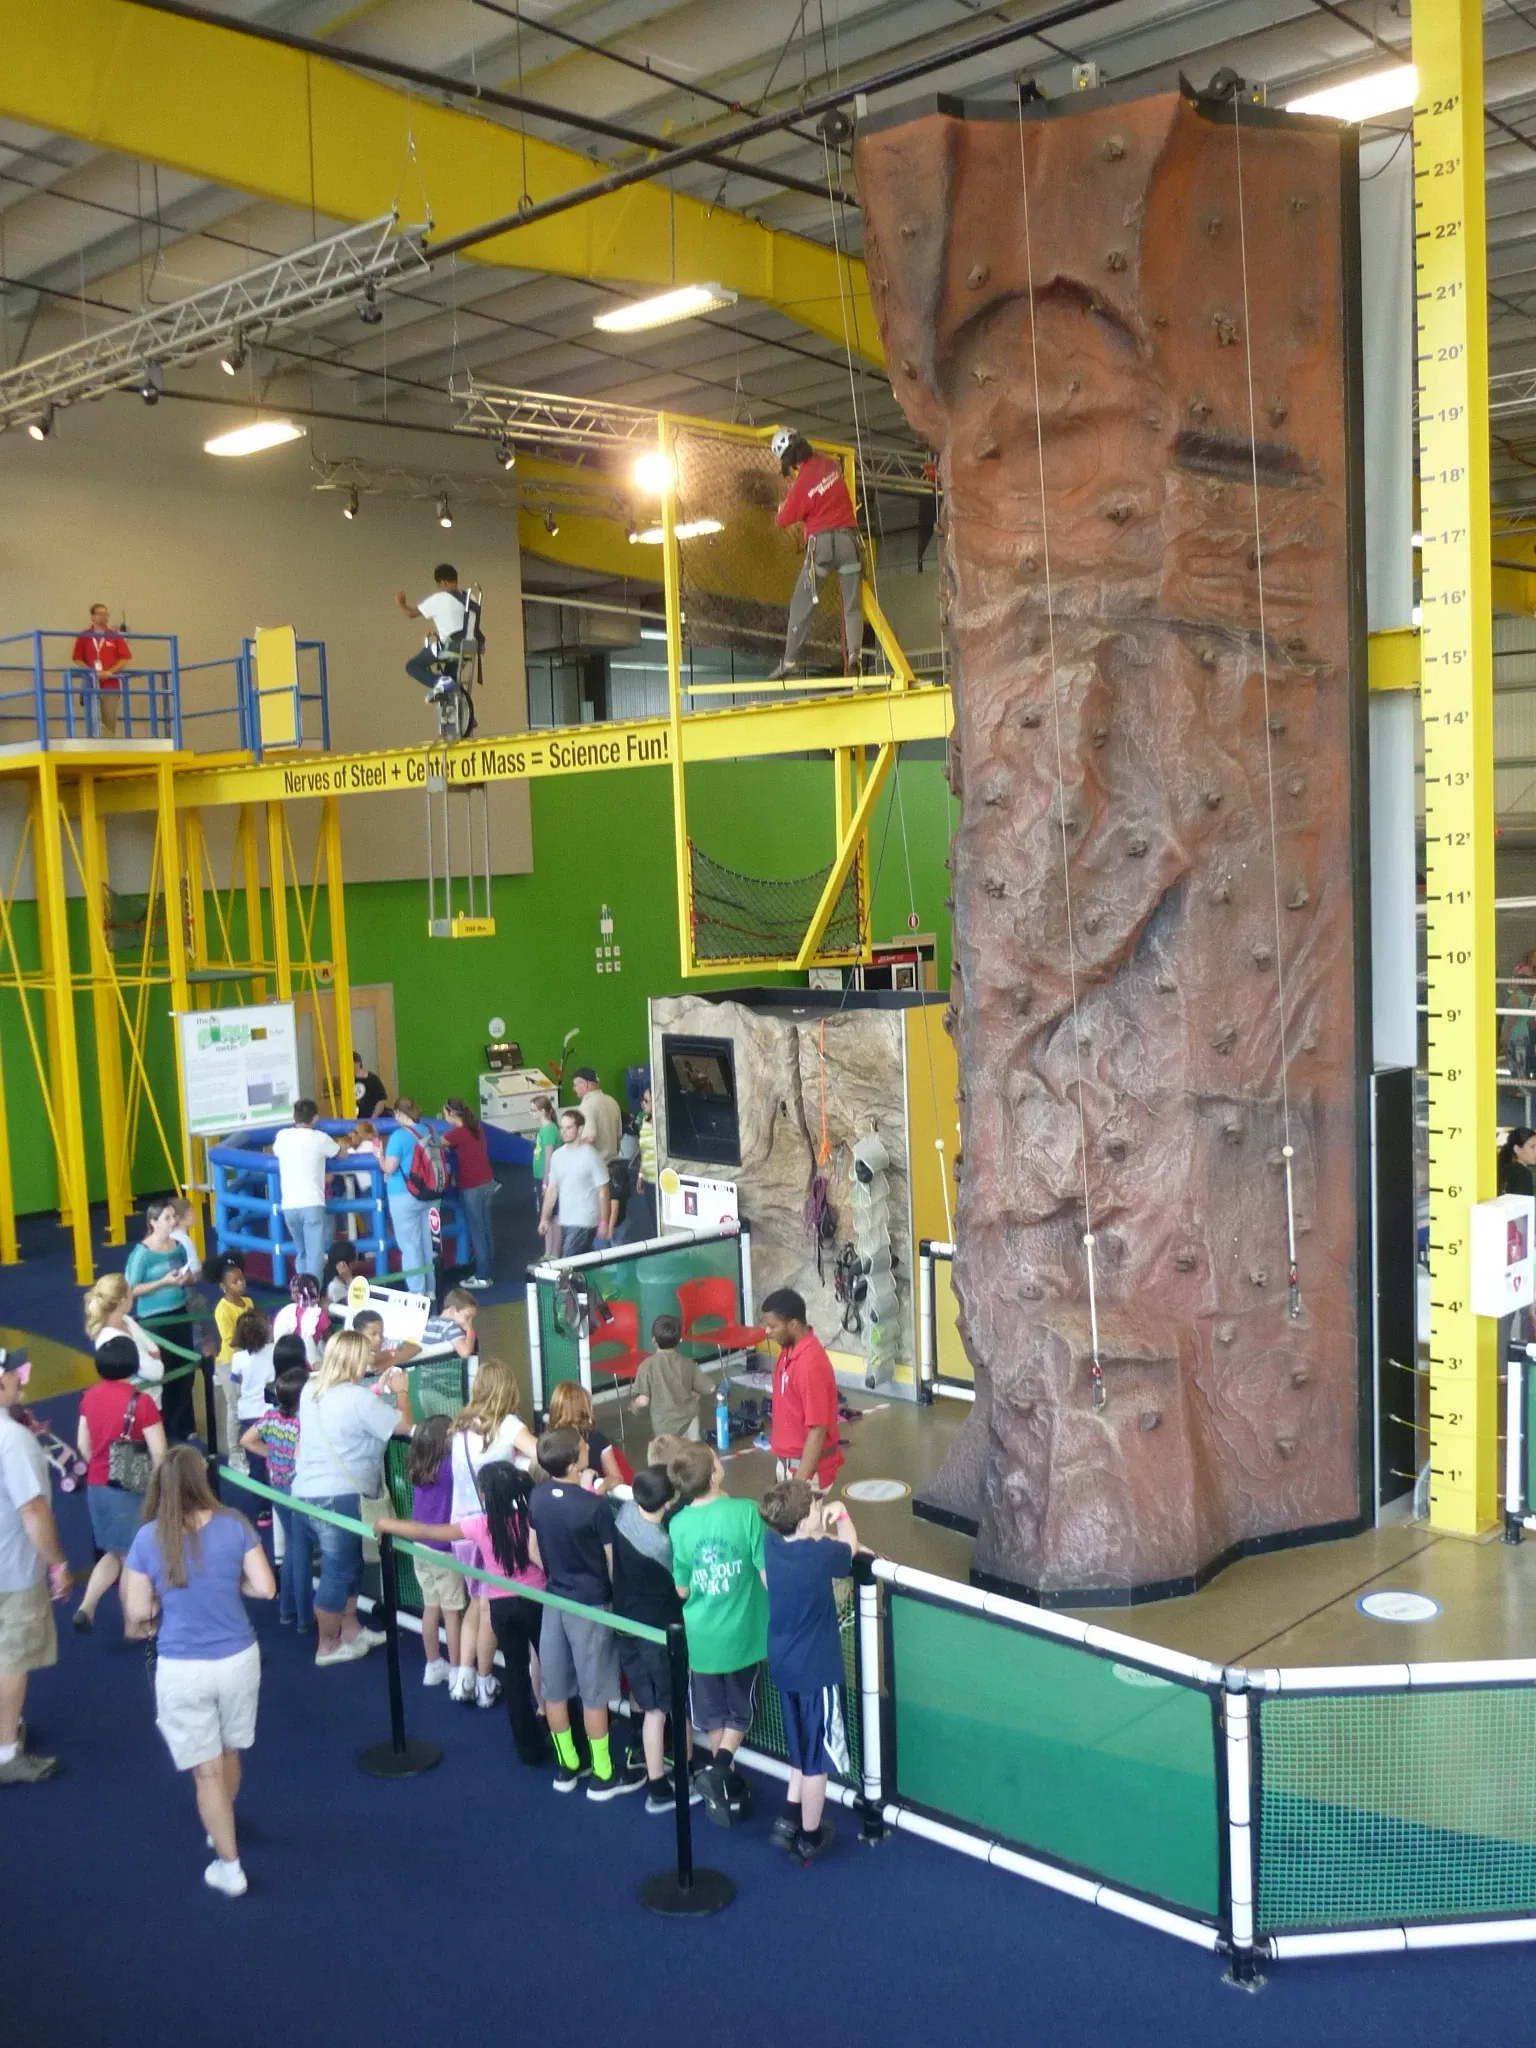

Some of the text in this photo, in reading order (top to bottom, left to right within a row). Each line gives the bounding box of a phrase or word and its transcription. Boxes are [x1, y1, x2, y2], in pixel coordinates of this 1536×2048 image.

[1433, 96, 1459, 116] 24'
[1434, 158, 1460, 177] 23'
[1435, 221, 1462, 239] 22'
[1436, 283, 1463, 300] 21'
[1437, 344, 1464, 362] 20'
[1438, 406, 1464, 422] 19'
[1439, 467, 1465, 483] 18'
[1440, 529, 1466, 544] 17'
[1440, 590, 1467, 605] 16'
[1441, 650, 1467, 665] 15'
[1443, 711, 1469, 725] 14'
[284, 731, 669, 793] Nerves of Steel + Center of Mass = Science Fun!
[1444, 772, 1470, 787] 13'
[1445, 833, 1470, 846] 12'
[1445, 891, 1471, 904] 11'
[1446, 951, 1471, 964] 10'
[1447, 1009, 1461, 1022] 9'
[1447, 1069, 1462, 1082] 8'
[1448, 1127, 1462, 1140] 7'
[1448, 1185, 1462, 1198] 6'
[1448, 1239, 1462, 1255] 5'
[1448, 1300, 1462, 1313] 4'
[1449, 1357, 1462, 1370] 3'
[1448, 1413, 1463, 1425] 2'
[1448, 1469, 1462, 1482] 1'
[710, 1559, 743, 1580] SOUT
